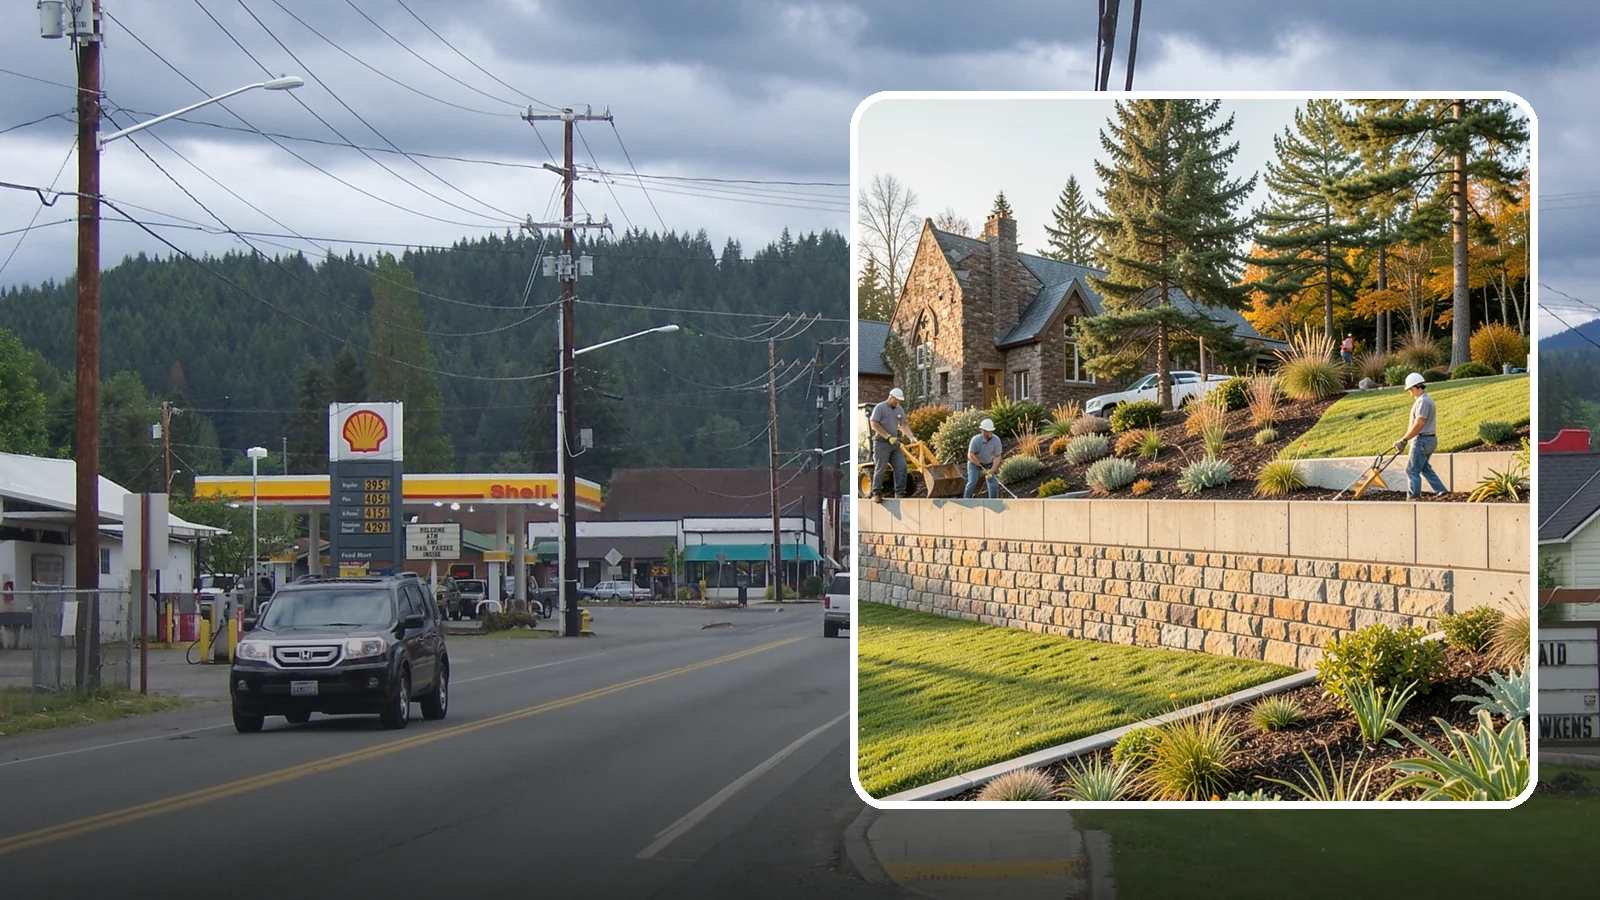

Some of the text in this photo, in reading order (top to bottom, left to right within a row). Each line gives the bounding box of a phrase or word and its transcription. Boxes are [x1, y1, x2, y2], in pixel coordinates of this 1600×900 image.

[366, 480, 383, 490] 395
[490, 484, 547, 498] Shell
[366, 494, 383, 504] 405
[366, 508, 383, 518] 415
[366, 522, 383, 532] 429
